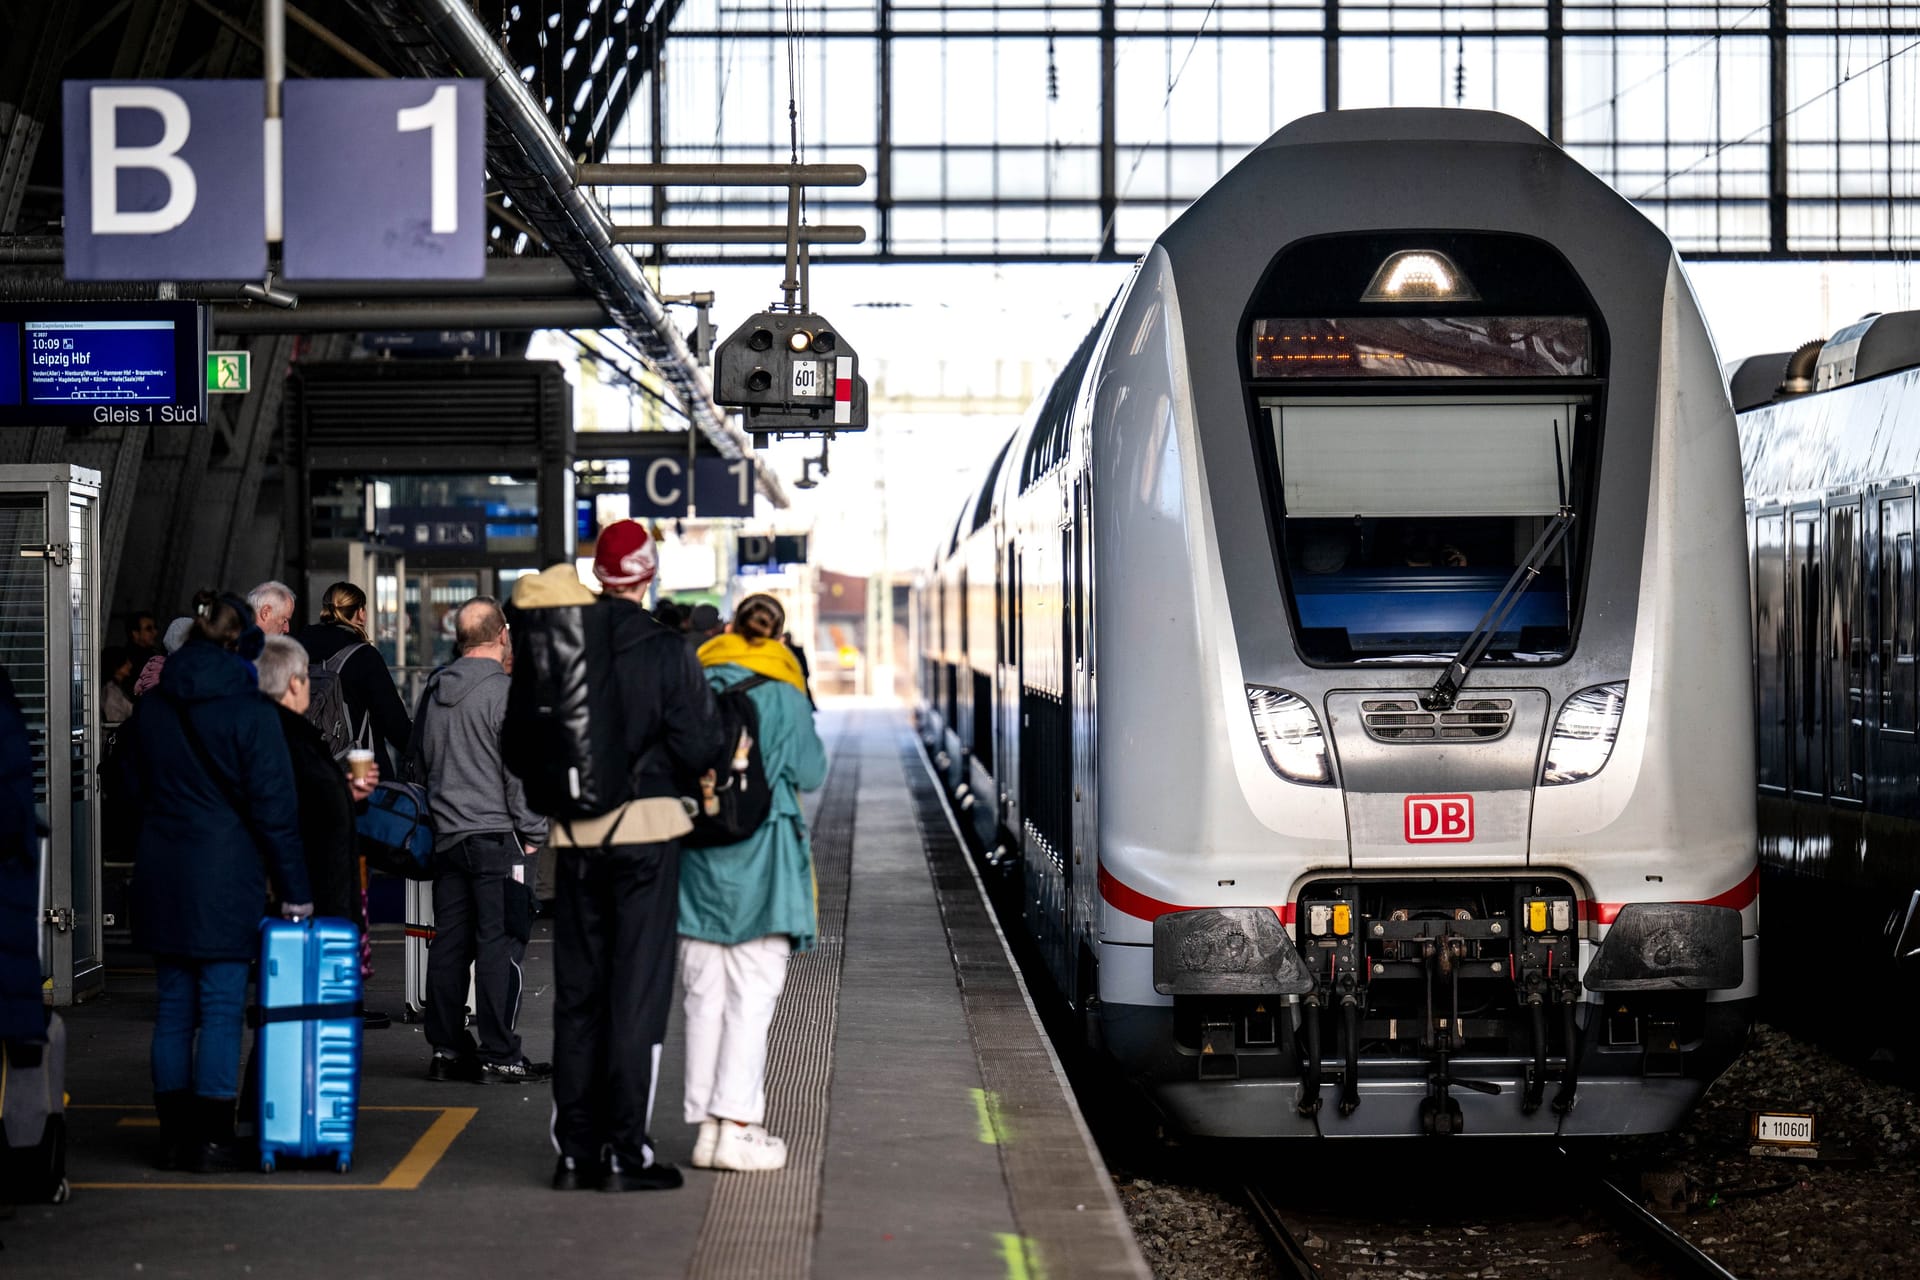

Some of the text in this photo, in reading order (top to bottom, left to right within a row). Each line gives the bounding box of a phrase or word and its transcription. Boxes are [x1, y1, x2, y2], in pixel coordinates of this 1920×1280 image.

[90, 85, 458, 235] B 1
[33, 338, 60, 350] 10:09
[33, 351, 91, 367] Leipzig Hbf
[795, 369, 815, 388] 601
[93, 405, 197, 423] Gleis 1 Süd
[645, 458, 749, 506] C 1
[744, 537, 768, 561] D
[1412, 802, 1467, 836] DB
[1773, 1122, 1809, 1137] 110601
